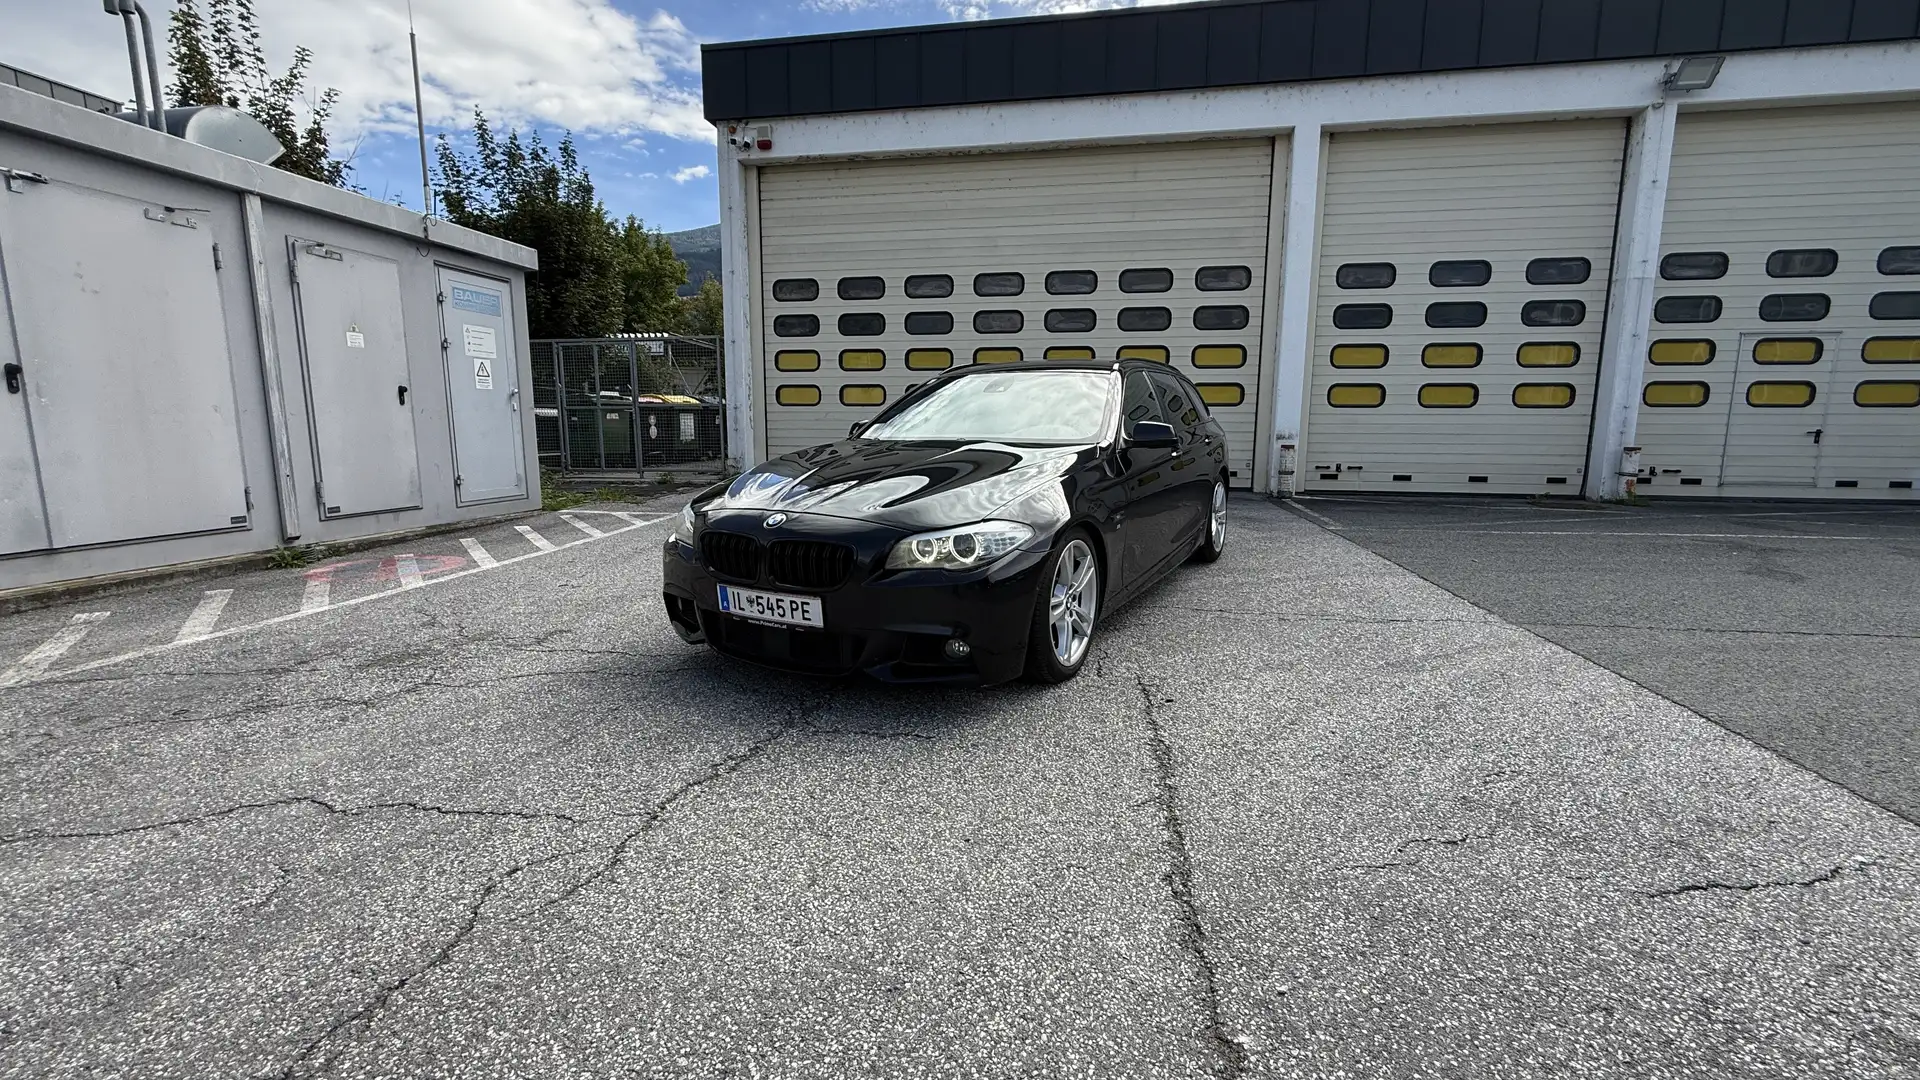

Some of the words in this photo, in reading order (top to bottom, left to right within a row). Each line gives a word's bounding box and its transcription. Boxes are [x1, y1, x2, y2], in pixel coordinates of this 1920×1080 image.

[732, 591, 745, 611] IL
[755, 595, 786, 617] 545
[789, 600, 812, 621] PE
